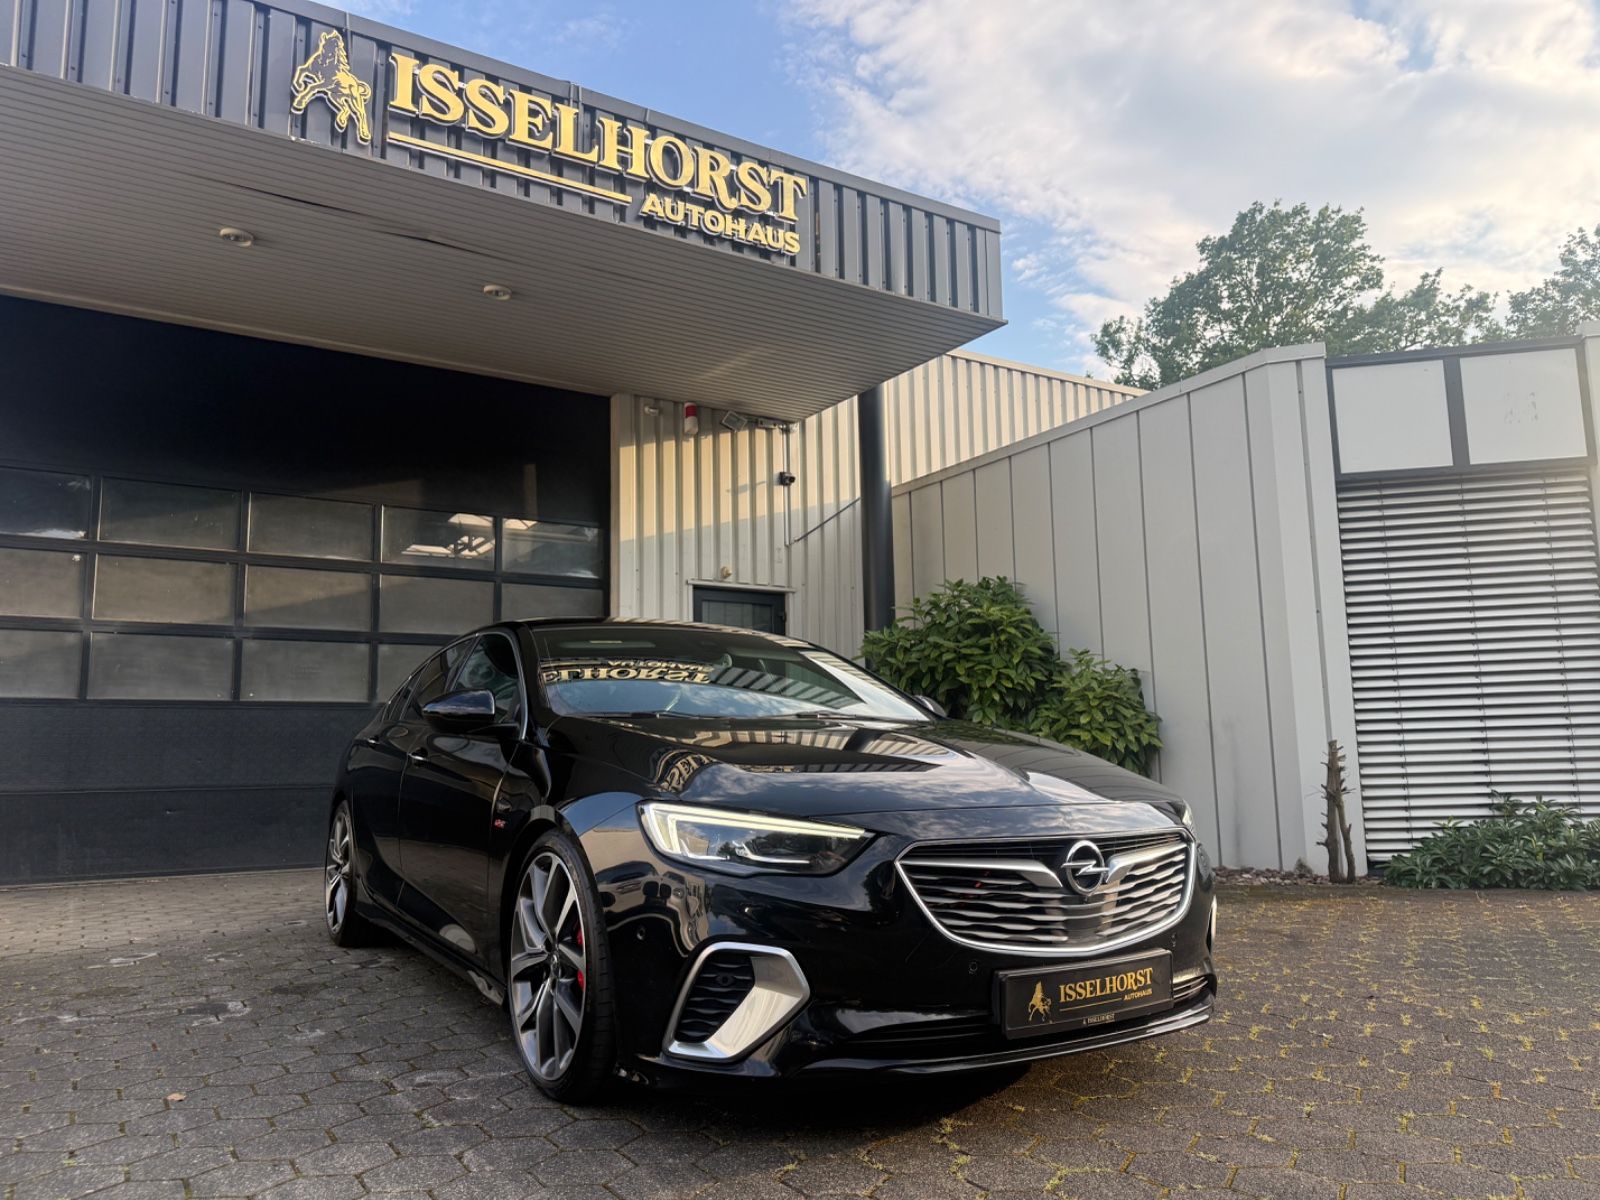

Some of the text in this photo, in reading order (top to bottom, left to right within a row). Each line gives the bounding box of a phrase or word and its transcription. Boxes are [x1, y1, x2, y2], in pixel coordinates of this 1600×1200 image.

[387, 52, 809, 223] ISSELHORST
[639, 192, 801, 256] AUTOHAUS
[1059, 967, 1153, 1003] ISSELHORST
